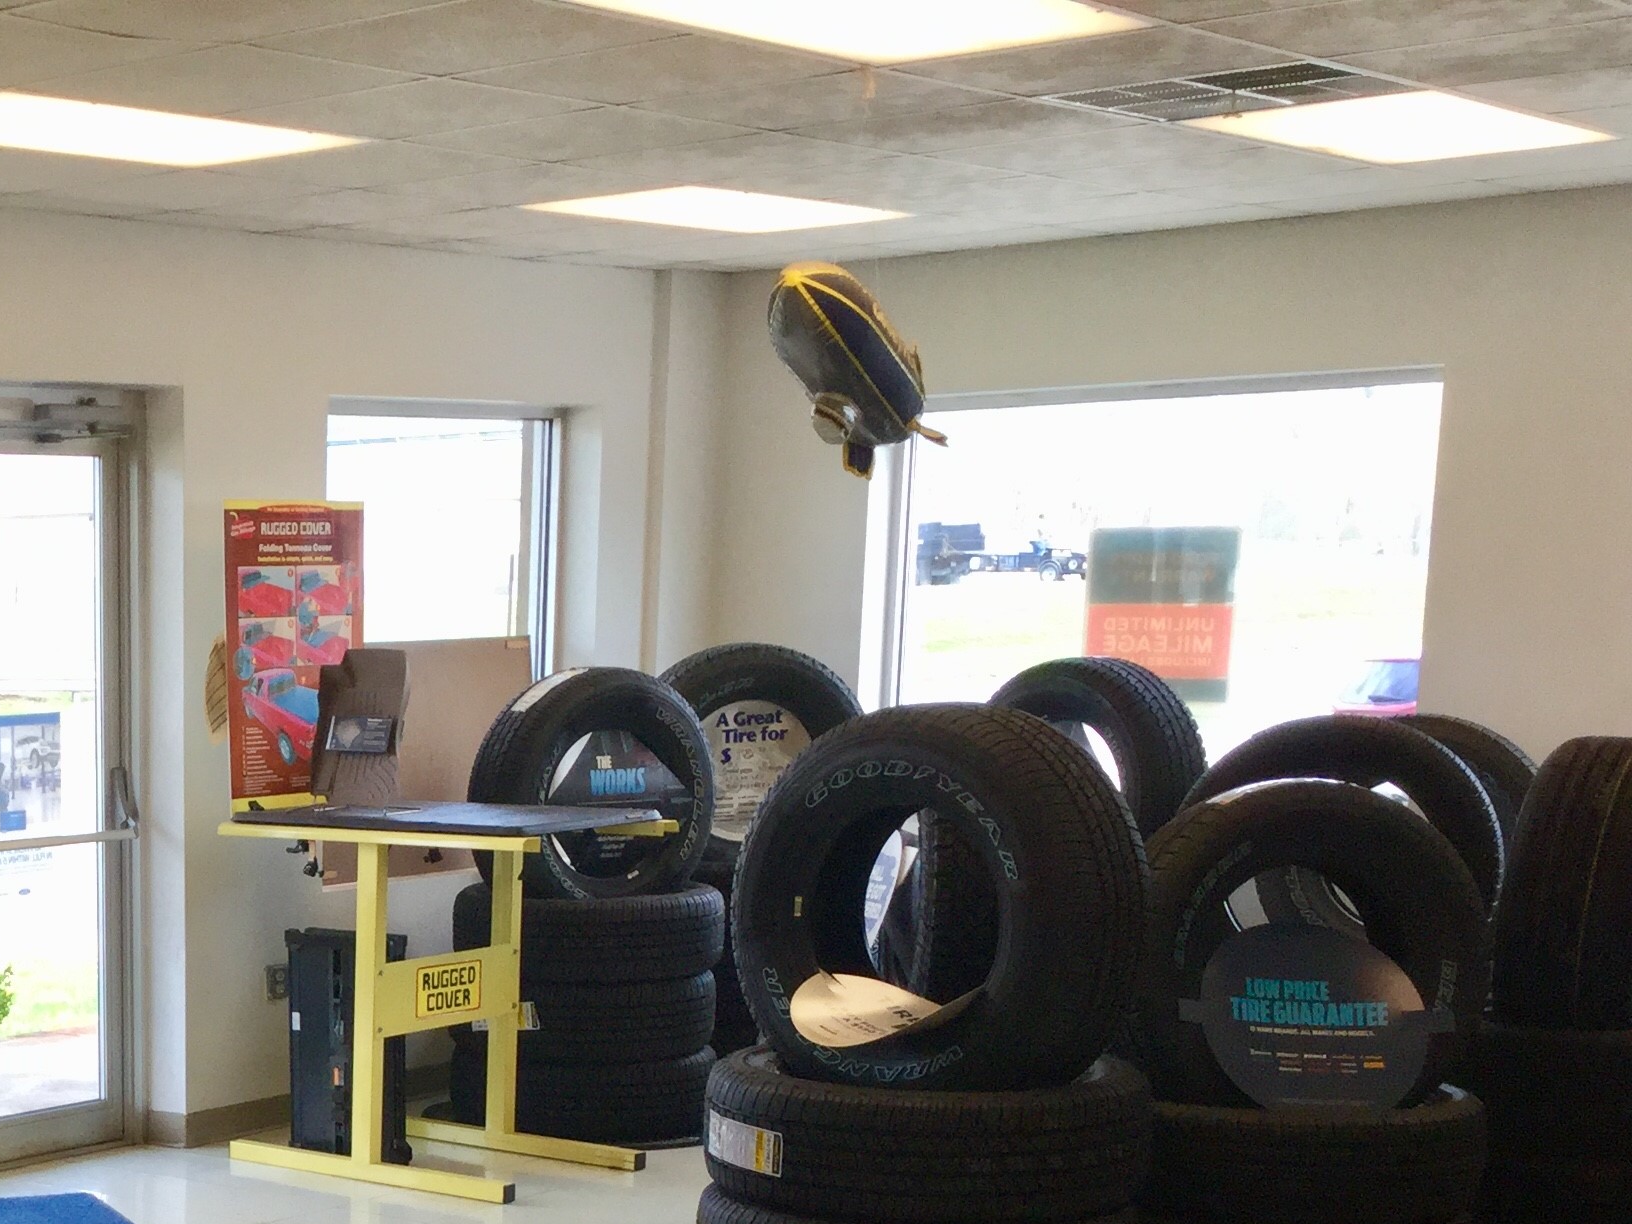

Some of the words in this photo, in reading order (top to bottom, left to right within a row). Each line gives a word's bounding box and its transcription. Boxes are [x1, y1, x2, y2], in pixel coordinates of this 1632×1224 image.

[260, 521, 298, 535] RUGGED
[299, 521, 332, 535] COVER
[258, 543, 283, 554] Folding
[312, 542, 333, 552] Cover
[715, 710, 730, 728] A
[733, 708, 784, 727] Great
[722, 726, 757, 744] Tire
[760, 724, 789, 742] for
[595, 755, 613, 769] THE
[720, 747, 732, 765] $
[589, 767, 647, 796] WORKS
[804, 759, 1019, 881] GOODYEAR
[422, 966, 476, 991] RUGGED
[1245, 976, 1282, 999] LOW
[1282, 979, 1329, 1001] PRICE
[426, 988, 471, 1012] COVER
[1230, 996, 1272, 1024] TIRE
[1272, 999, 1389, 1027] GUARANTEE
